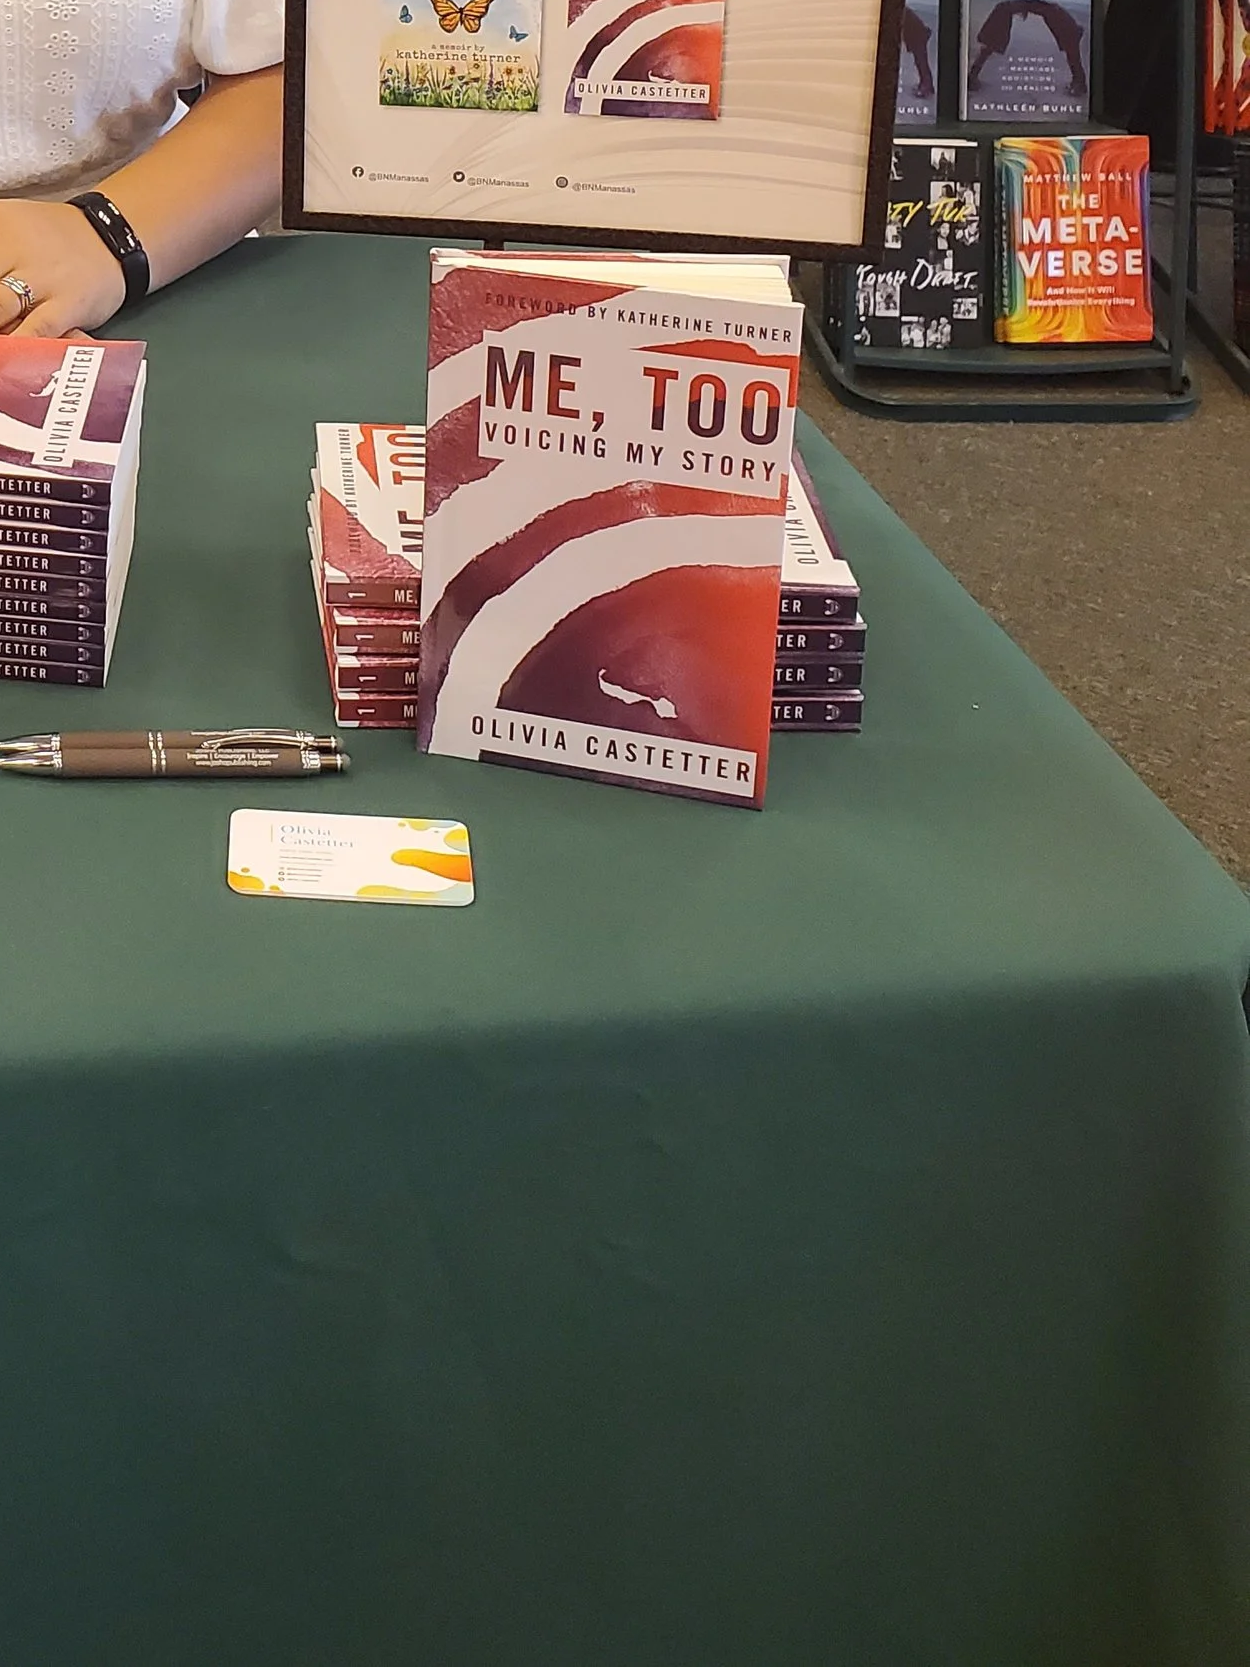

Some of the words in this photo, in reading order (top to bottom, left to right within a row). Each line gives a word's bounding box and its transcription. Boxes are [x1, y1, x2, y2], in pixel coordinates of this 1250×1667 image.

[396, 50, 467, 63] katherine
[472, 53, 521, 63] turner
[578, 82, 623, 95] OLIVIA
[631, 86, 706, 99] CASTETTER
[974, 102, 1037, 113] KATHLEEN
[1043, 103, 1082, 113] BUHLE
[368, 173, 429, 184] @BNManassas
[467, 177, 529, 189] @BNManassas
[1023, 172, 1091, 184] MATTHEW
[1099, 172, 1131, 182] BALL
[572, 182, 636, 194] @BNManassas
[1058, 194, 1100, 209] THE
[1021, 217, 1138, 244] META-
[1017, 249, 1143, 278] VERSE
[485, 293, 577, 316] FOREWORD
[588, 305, 607, 319] BY
[617, 310, 713, 334] KATHERINE
[724, 323, 792, 343] TURNER
[484, 345, 605, 432] ME,
[643, 365, 780, 447] TOO
[484, 423, 607, 460] VOICING
[627, 442, 663, 466] MY
[682, 451, 776, 482] STORY
[471, 716, 568, 752] OLIVIA
[585, 736, 751, 783] CASTETTER
[280, 824, 332, 836] Olivia
[280, 836, 355, 848] Castetter
